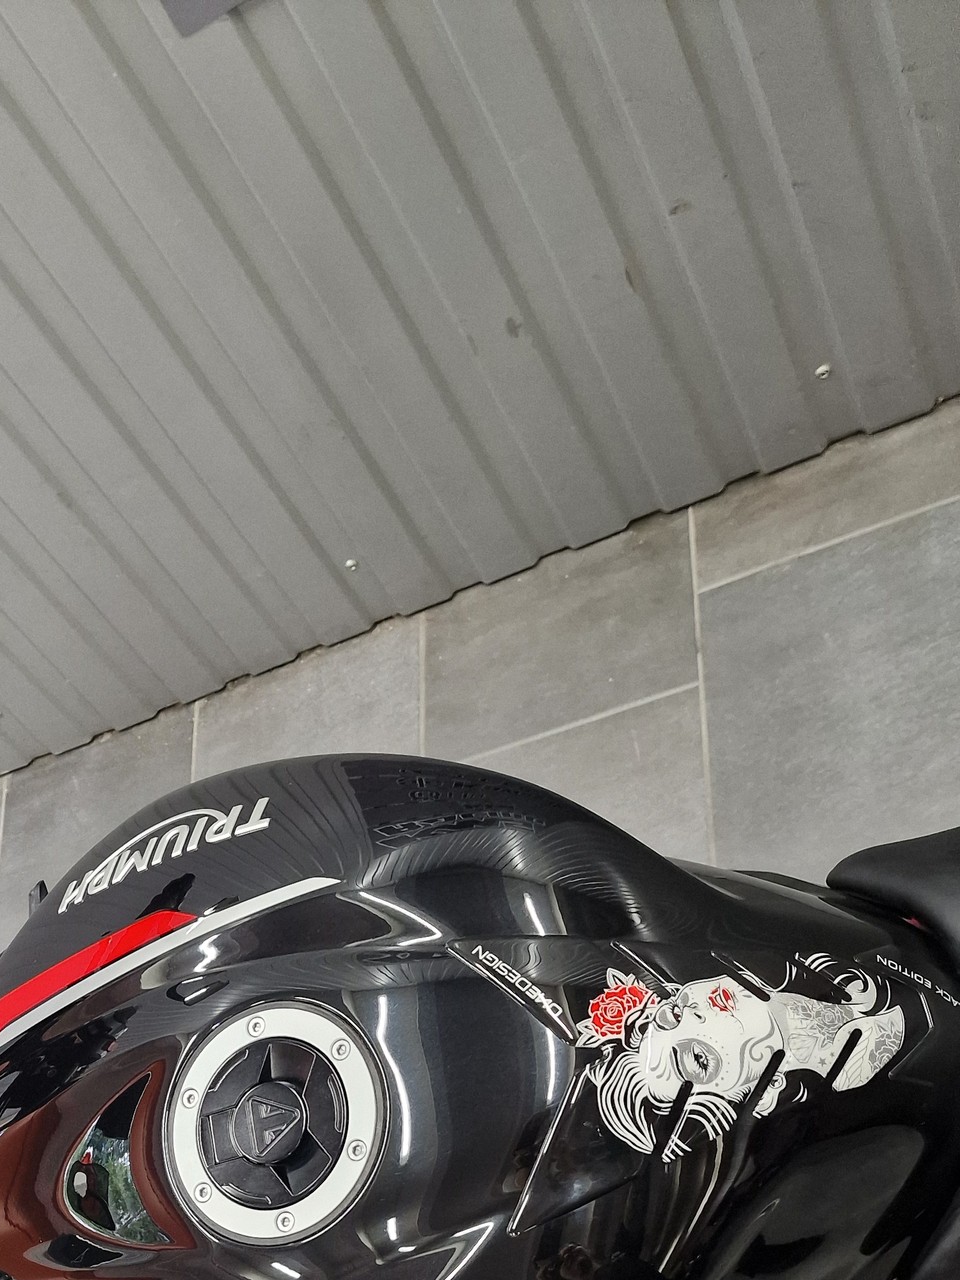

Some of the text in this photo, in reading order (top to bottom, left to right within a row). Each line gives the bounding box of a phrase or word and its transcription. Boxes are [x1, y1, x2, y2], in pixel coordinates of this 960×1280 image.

[58, 797, 272, 915] TRIUMPH
[876, 954, 960, 1006] ACK EDITION
